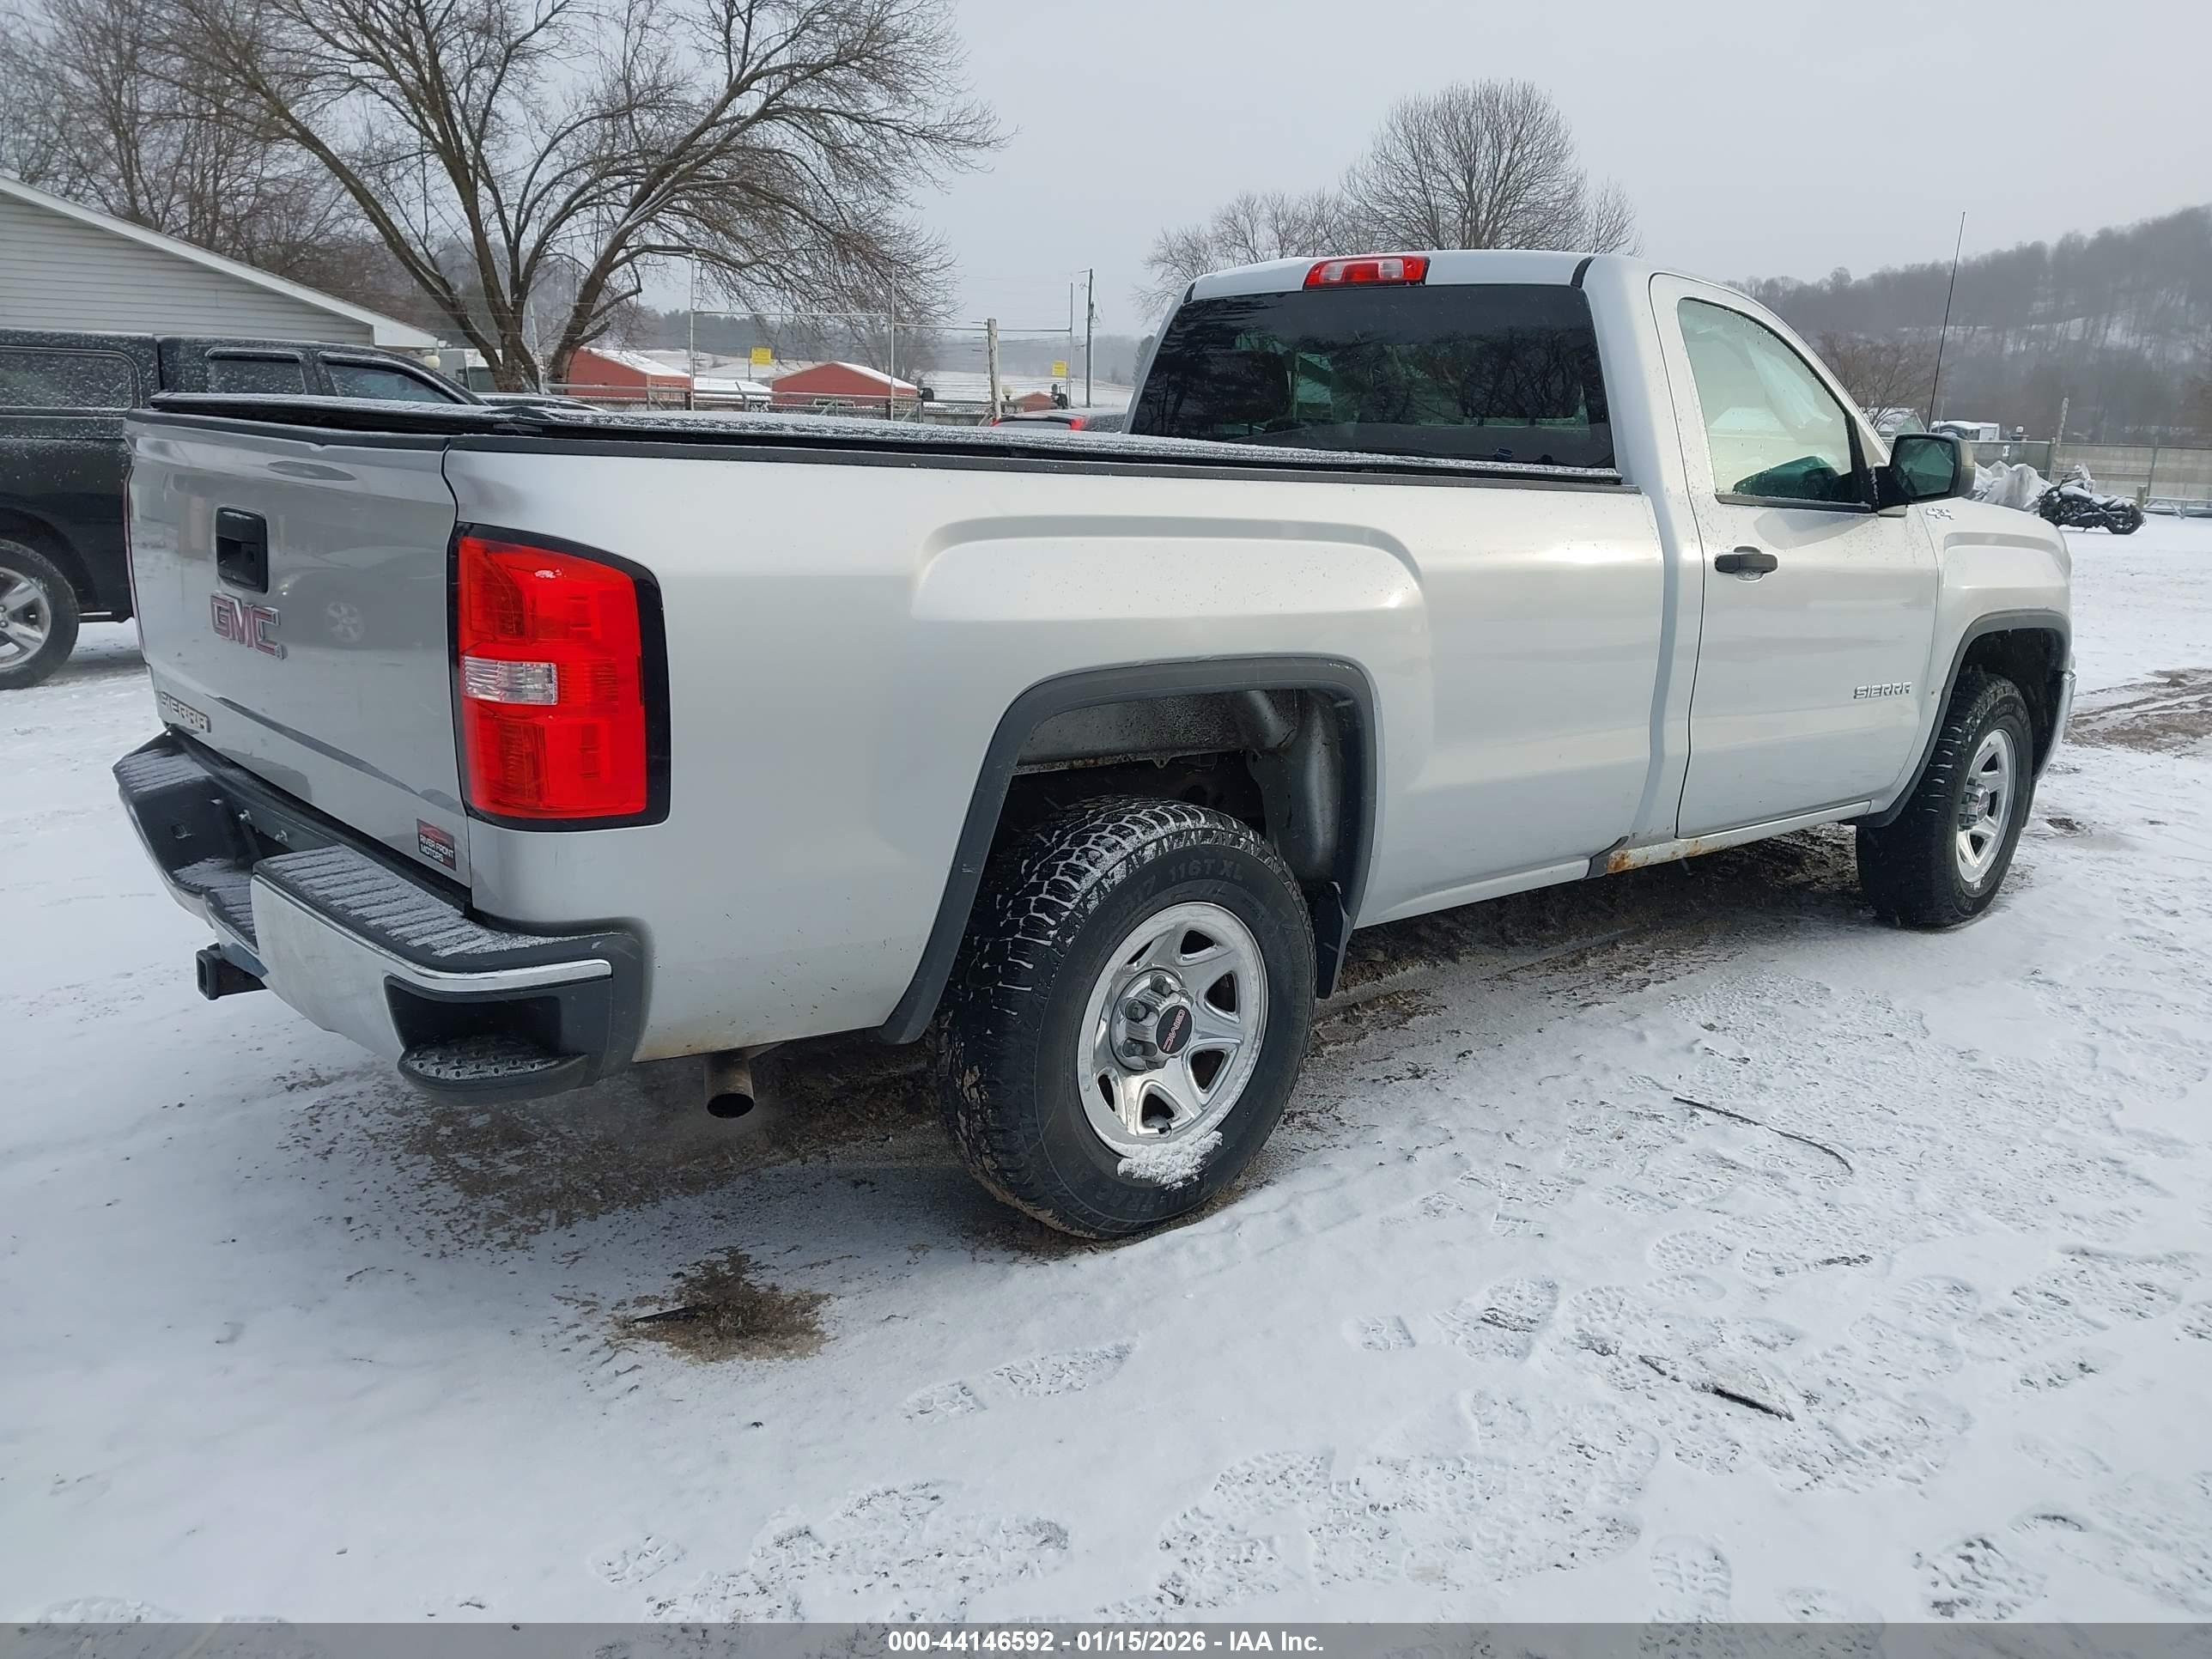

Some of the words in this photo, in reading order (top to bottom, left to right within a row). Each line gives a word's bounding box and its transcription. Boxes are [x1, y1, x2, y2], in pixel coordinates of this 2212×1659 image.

[210, 591, 284, 659] GMC
[1854, 682, 1911, 699] SIERRA
[1163, 1009, 1186, 1052] GMC
